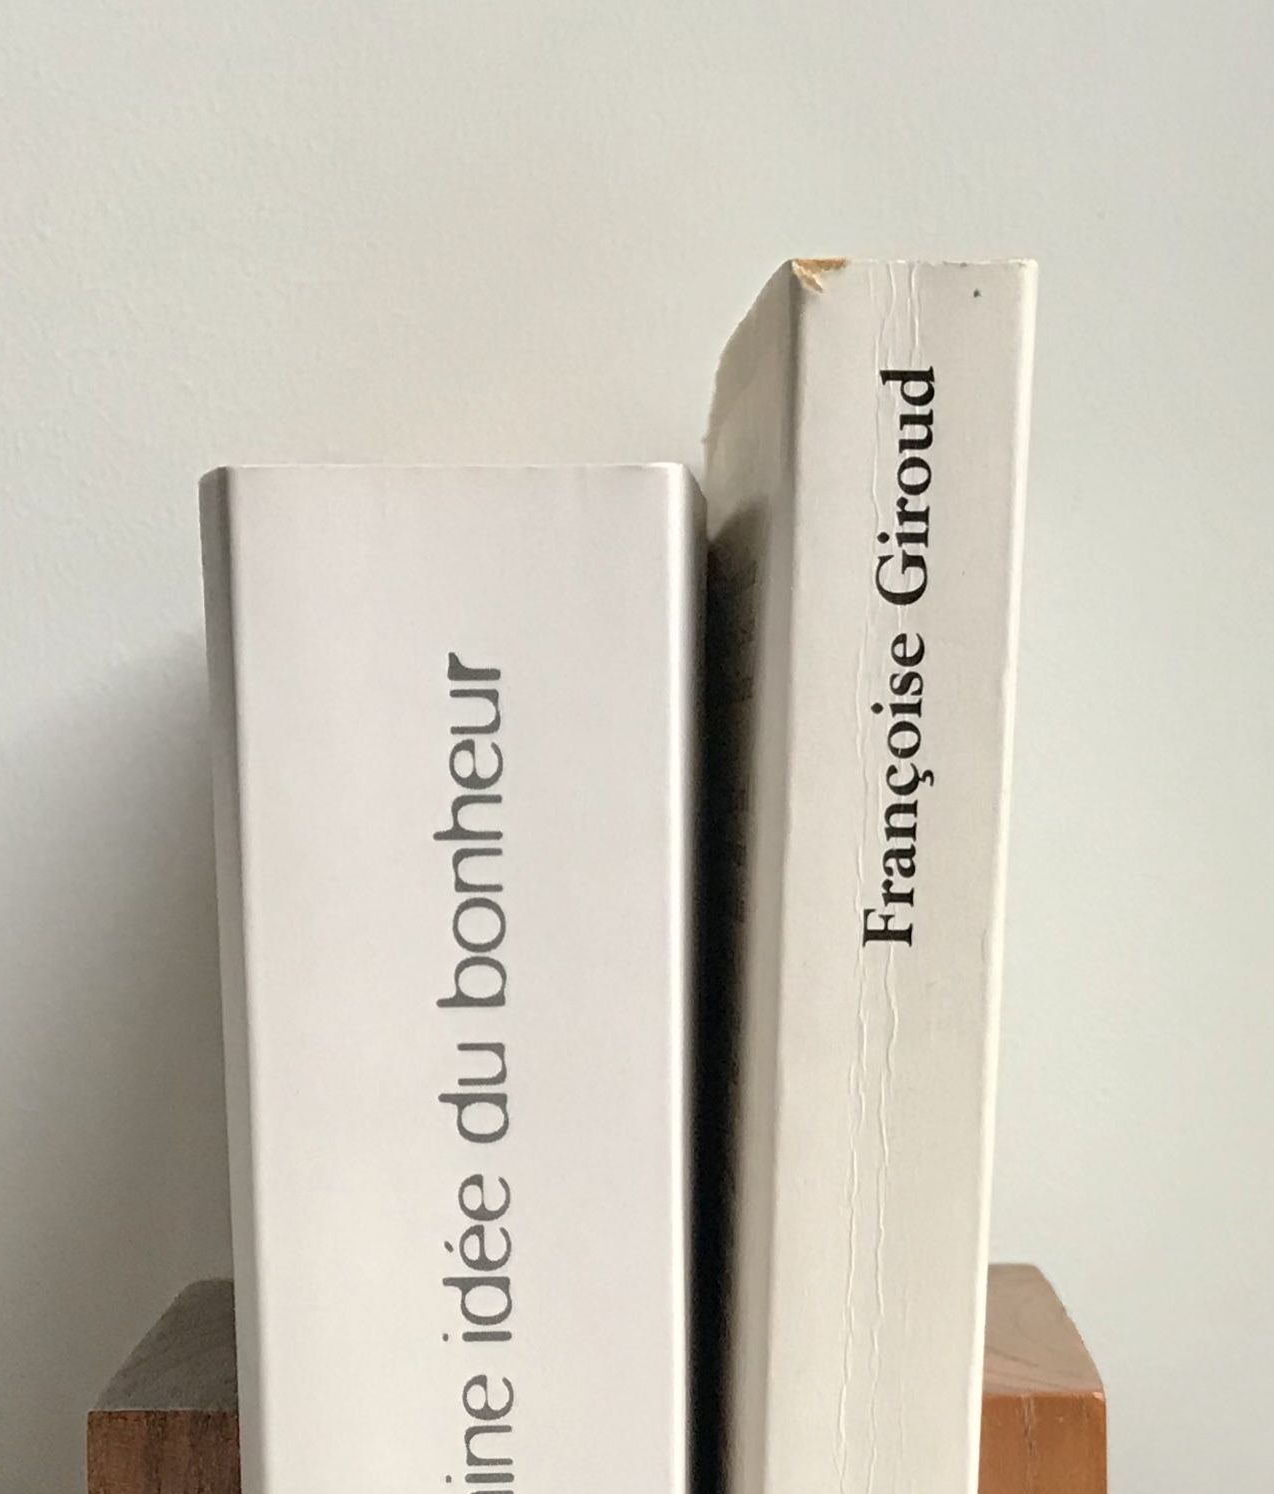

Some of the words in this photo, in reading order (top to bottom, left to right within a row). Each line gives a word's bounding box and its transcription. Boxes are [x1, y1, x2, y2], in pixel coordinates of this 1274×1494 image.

[875, 365, 936, 606] Giroud
[432, 651, 508, 1009] bonheur
[862, 633, 935, 948] Françoise
[437, 1042, 510, 1144] du
[442, 1173, 513, 1343] idée
